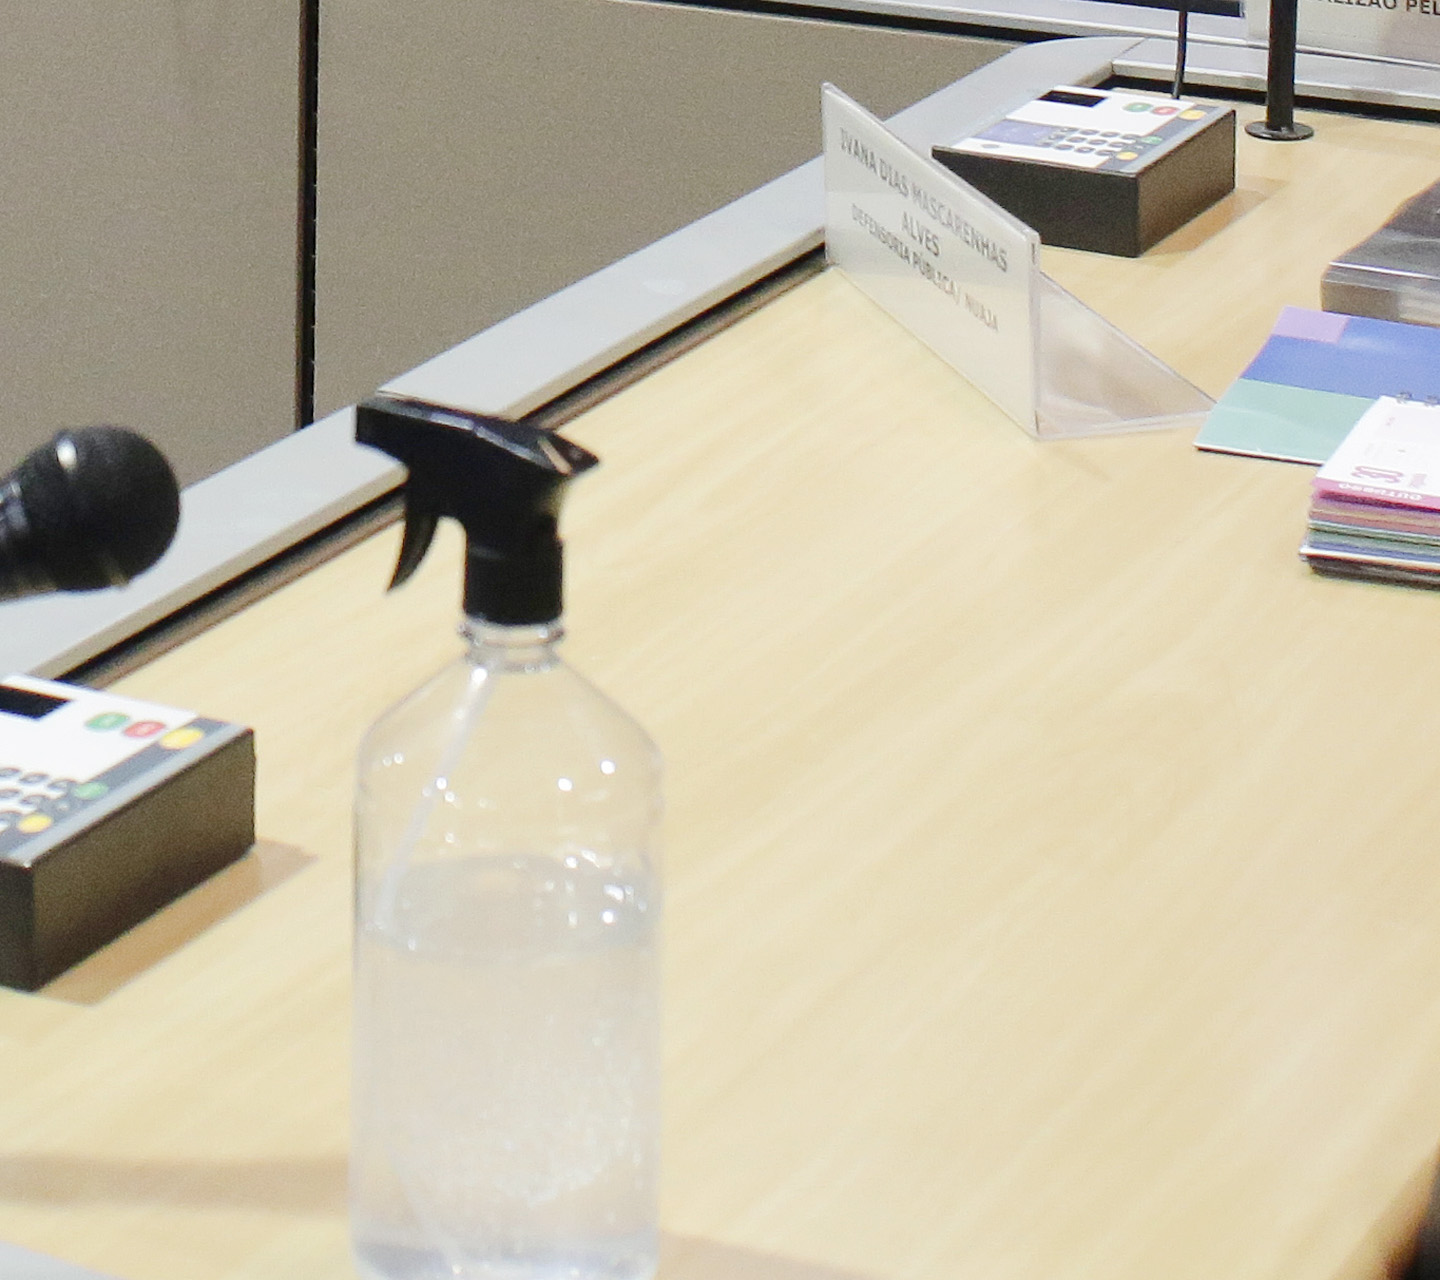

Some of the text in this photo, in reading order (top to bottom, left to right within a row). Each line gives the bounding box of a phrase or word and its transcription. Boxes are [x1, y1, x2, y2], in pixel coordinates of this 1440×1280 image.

[839, 127, 1008, 273] IVANA DIAS MASCARENHAS
[852, 203, 911, 265] DEFENSORIA
[901, 211, 940, 257] ALVES
